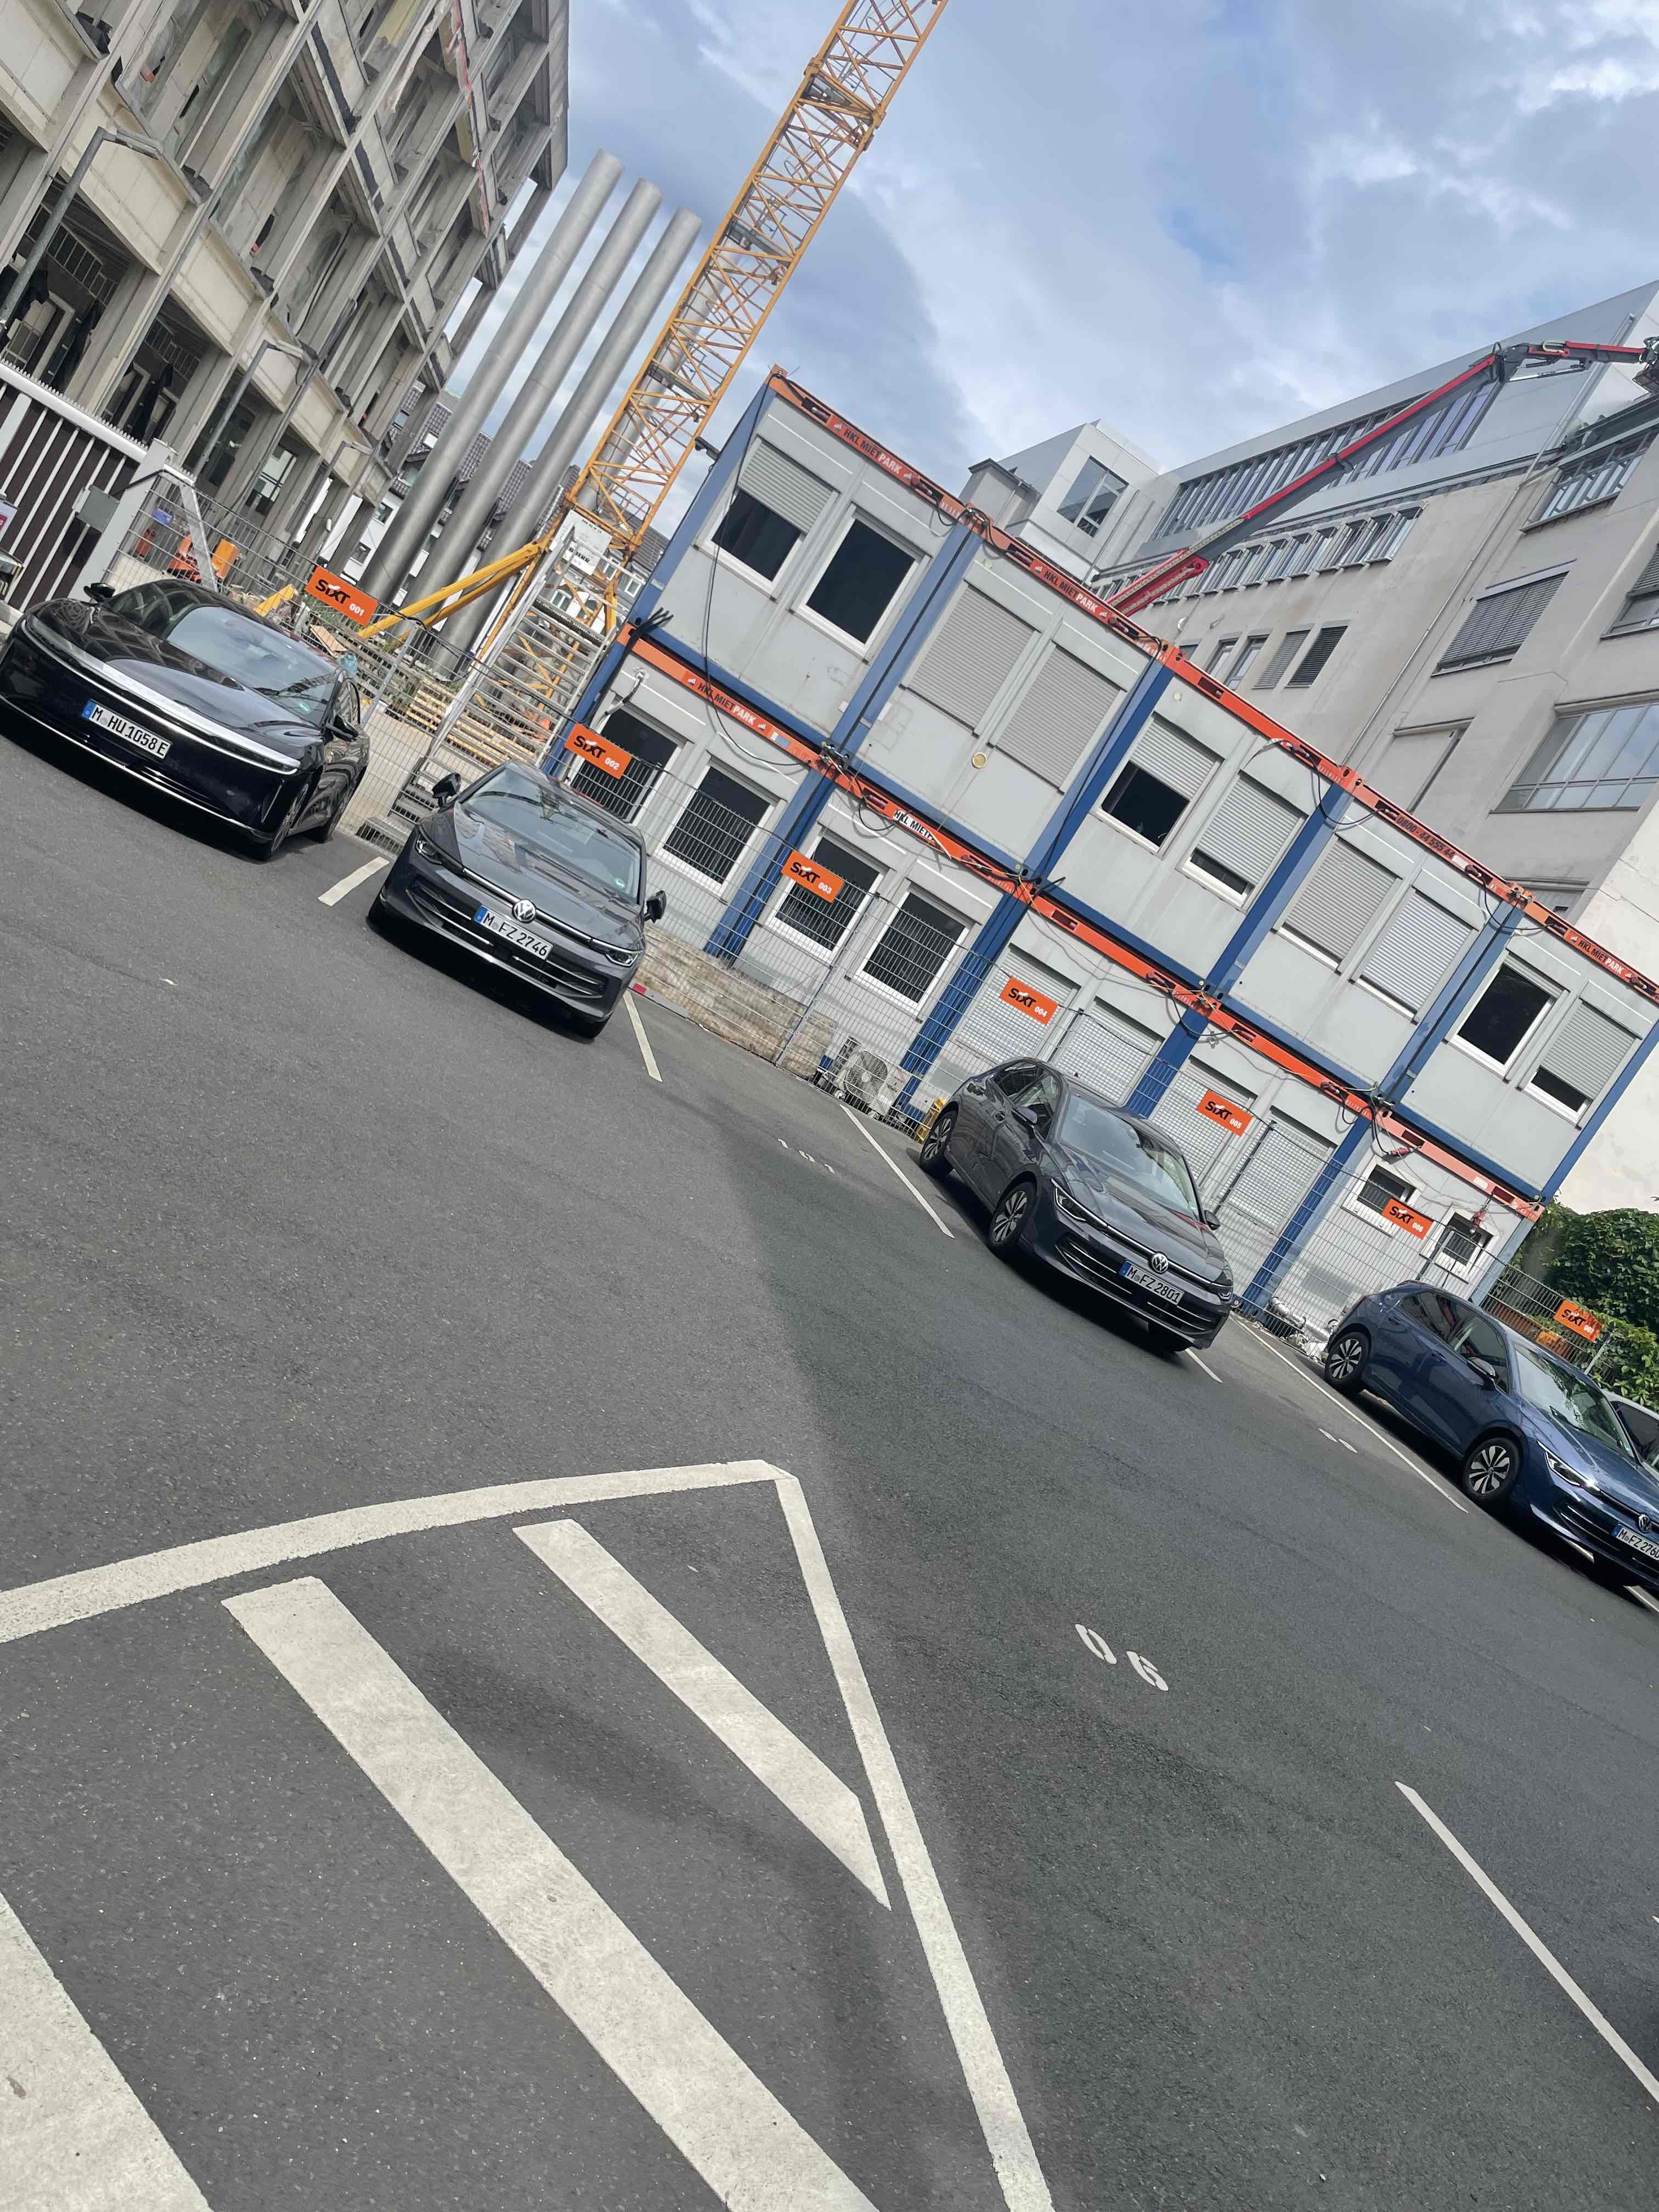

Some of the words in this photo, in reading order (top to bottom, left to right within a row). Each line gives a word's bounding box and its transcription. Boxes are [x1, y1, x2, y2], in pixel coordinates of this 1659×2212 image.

[844, 428, 859, 445] HKL
[349, 603, 364, 616] 001
[714, 693, 756, 725] MIETPARK
[92, 707, 104, 721] M
[108, 715, 126, 734] HU
[605, 757, 620, 770] 002
[817, 882, 832, 894] 003
[483, 913, 495, 926] M
[499, 922, 517, 939] FZ
[516, 933, 548, 956] 2746
[1591, 949, 1624, 974] MIETPARK
[1034, 1006, 1048, 1018] 004
[1229, 1118, 1243, 1129] 005
[1127, 1267, 1138, 1279] M
[1139, 1274, 1155, 1289] FZ
[1154, 1283, 1181, 1303] 2801
[1618, 1529, 1628, 1539] M
[1628, 1535, 1643, 1548] FZ
[1075, 1624, 1169, 1691] 06
